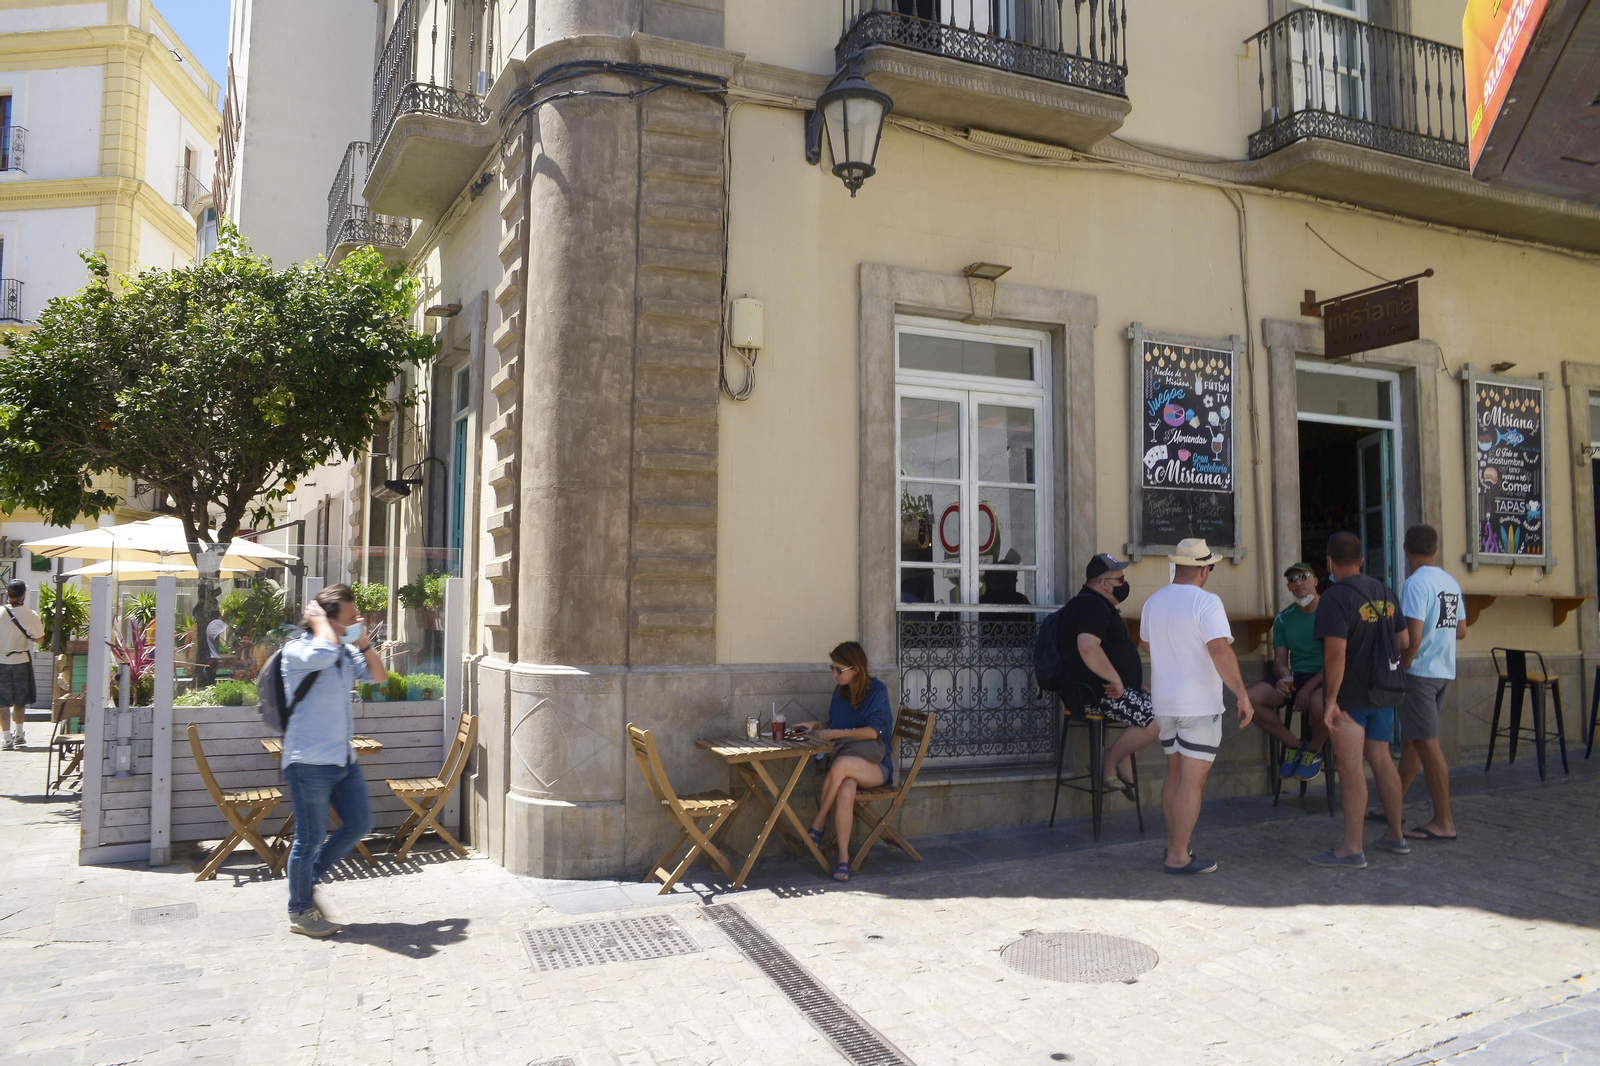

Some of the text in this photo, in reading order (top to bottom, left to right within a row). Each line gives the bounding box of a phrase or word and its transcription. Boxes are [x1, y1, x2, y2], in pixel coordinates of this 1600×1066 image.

[1328, 296, 1414, 332] misiana
[1175, 369, 1182, 378] de
[1147, 387, 1186, 416] Juegos
[1216, 393, 1228, 403] TV
[1483, 406, 1534, 430] Misiana
[1192, 452, 1209, 467] Gran
[1487, 457, 1524, 467] acostumbra
[1155, 459, 1224, 485] Misiana
[1501, 480, 1532, 493] Comer
[1494, 499, 1526, 513] TAPAS
